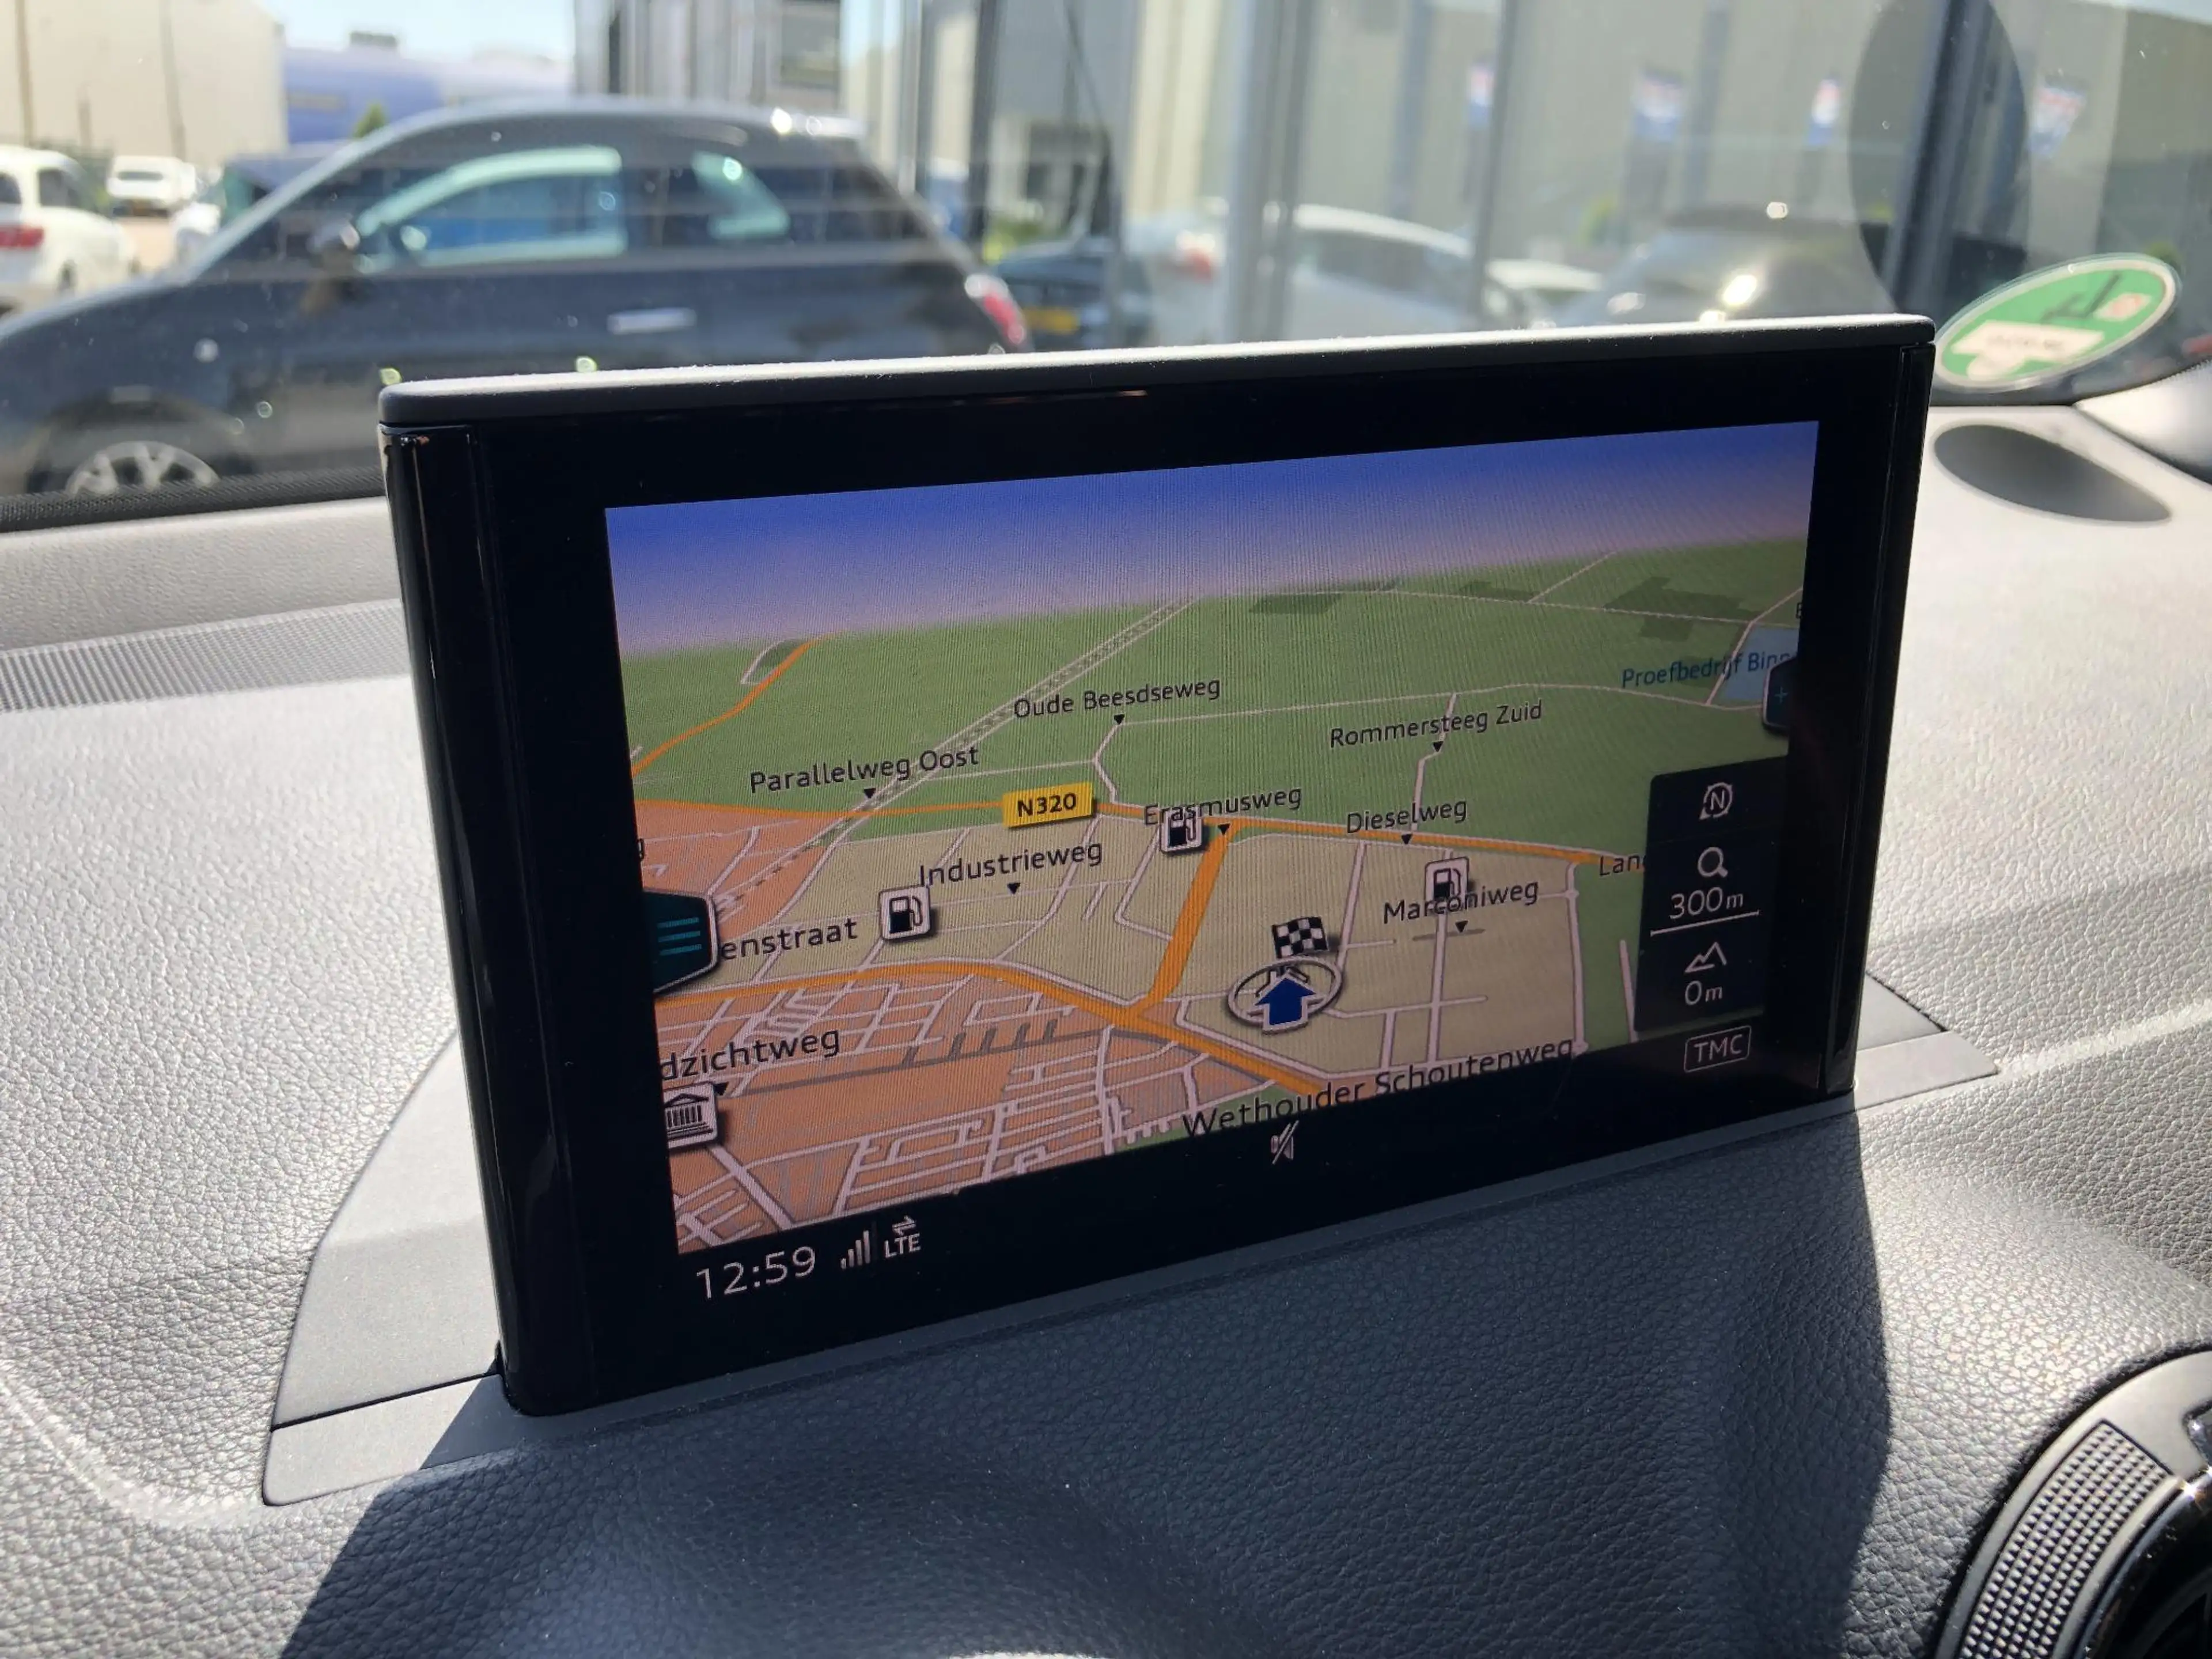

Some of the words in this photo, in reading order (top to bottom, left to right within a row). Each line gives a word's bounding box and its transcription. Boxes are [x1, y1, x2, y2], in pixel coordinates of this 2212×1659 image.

[1622, 653, 1742, 688] Proefbedrijf
[1014, 695, 1073, 719] Oude
[1085, 679, 1220, 710] Beesdseweg
[1330, 711, 1488, 748] Rommersteeg
[1497, 700, 1543, 725] Zuid
[751, 757, 910, 793] Parallelweg
[919, 747, 979, 771] Oost
[1017, 792, 1077, 817] N320
[1144, 788, 1301, 825] Erasmusweg
[1347, 801, 1467, 833] Dieselweg
[920, 843, 1101, 885] Industrieweg
[1384, 881, 1539, 924] Marconiweg
[722, 918, 857, 960] enstraat
[1694, 1033, 1743, 1062] TMC
[1183, 1081, 1365, 1138] Wethouder
[884, 1233, 921, 1258] LTE
[696, 1246, 816, 1298] 12:59
